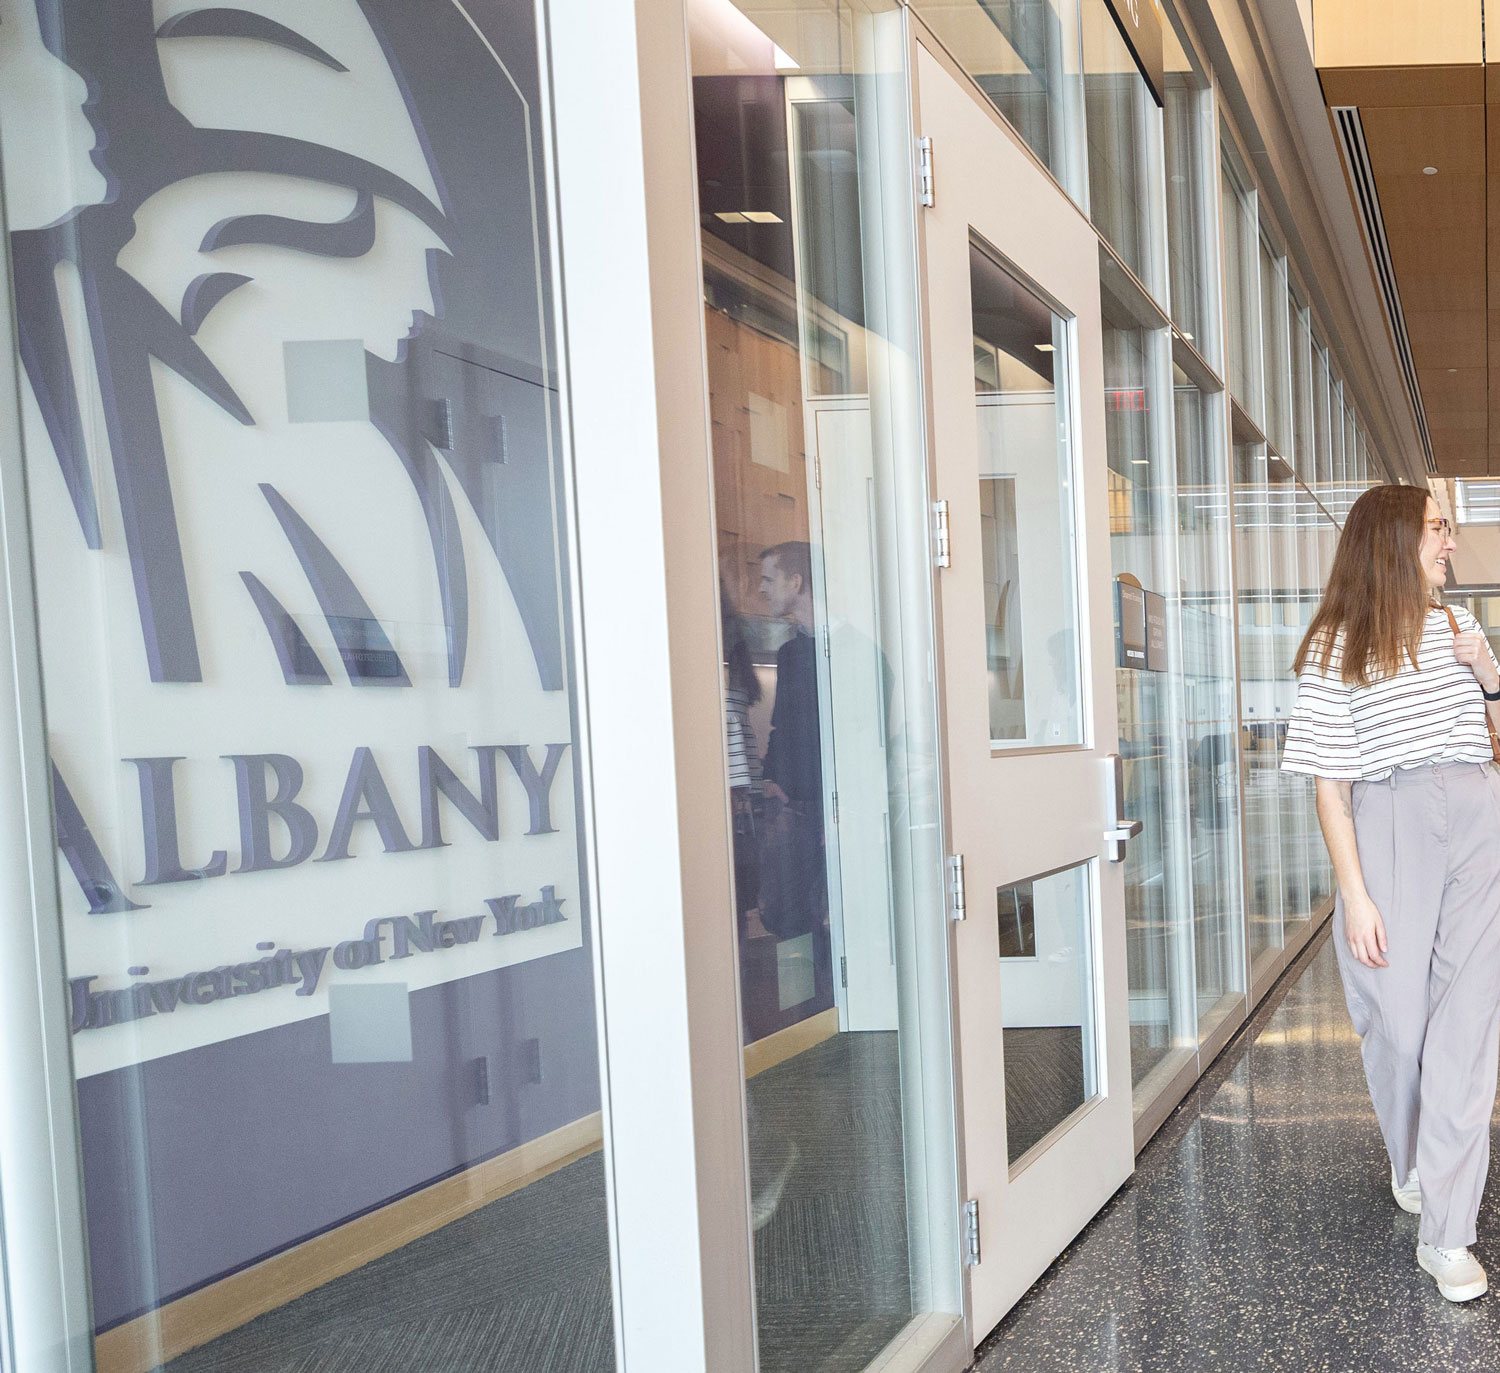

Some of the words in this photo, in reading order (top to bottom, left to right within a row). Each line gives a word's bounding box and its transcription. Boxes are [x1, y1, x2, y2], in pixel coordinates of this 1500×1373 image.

[333, 917, 391, 970] of
[389, 910, 486, 959] New
[484, 885, 568, 936] York
